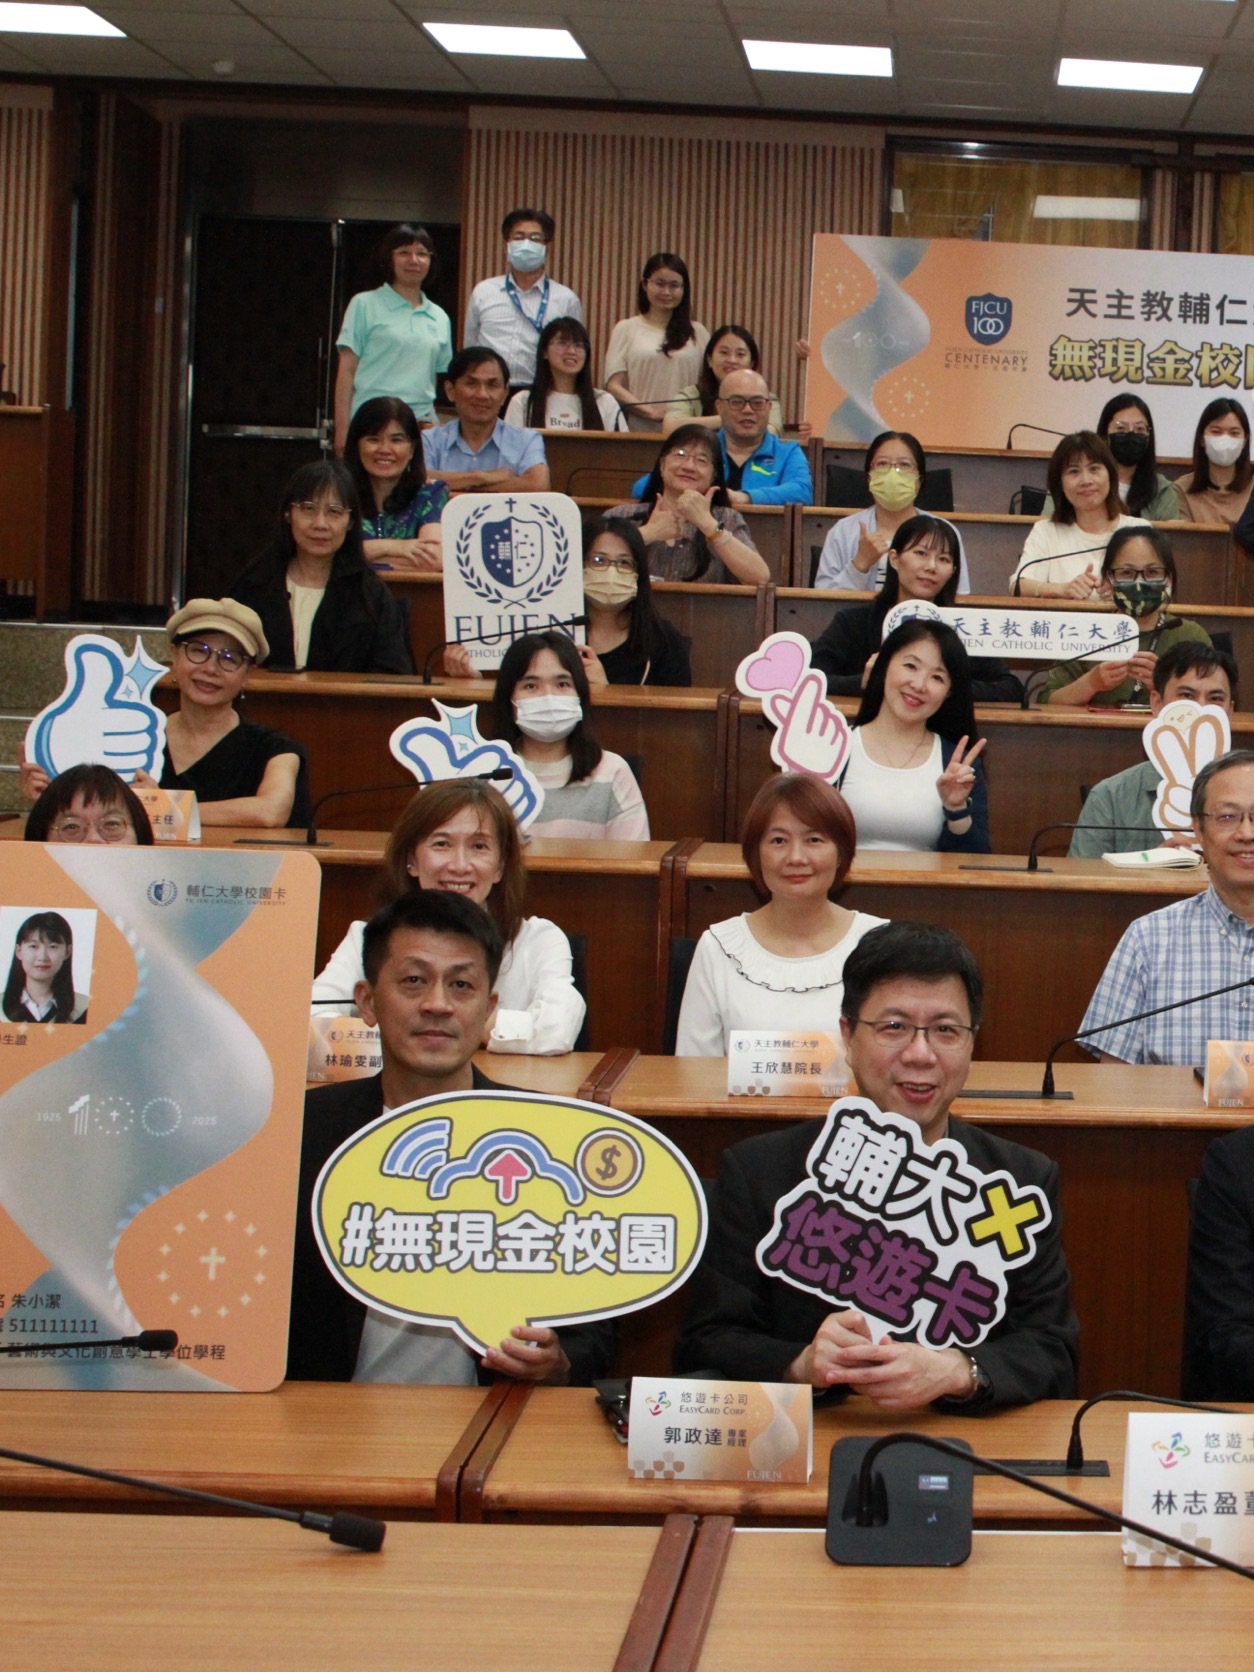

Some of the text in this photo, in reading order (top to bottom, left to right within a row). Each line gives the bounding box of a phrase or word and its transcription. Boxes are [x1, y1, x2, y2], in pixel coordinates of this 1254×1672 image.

[971, 300, 1008, 316] FJCU
[945, 352, 1028, 366] CENTENARY
[550, 417, 580, 428] Bread
[953, 617, 1132, 641] 天主教輔仁大學
[992, 639, 1053, 651] CATHOLIC
[1061, 643, 1132, 653] UNIVERSITY
[187, 884, 287, 900] 輔仁大學校園卡
[751, 1061, 822, 1075] 王欣慧院長
[340, 1202, 677, 1275] #無現金校園
[11, 1293, 62, 1310] 朱小潔
[9, 1318, 99, 1333] 511111111
[680, 1391, 749, 1405] 悠遊卡公司
[664, 1426, 723, 1446] 郭政達
